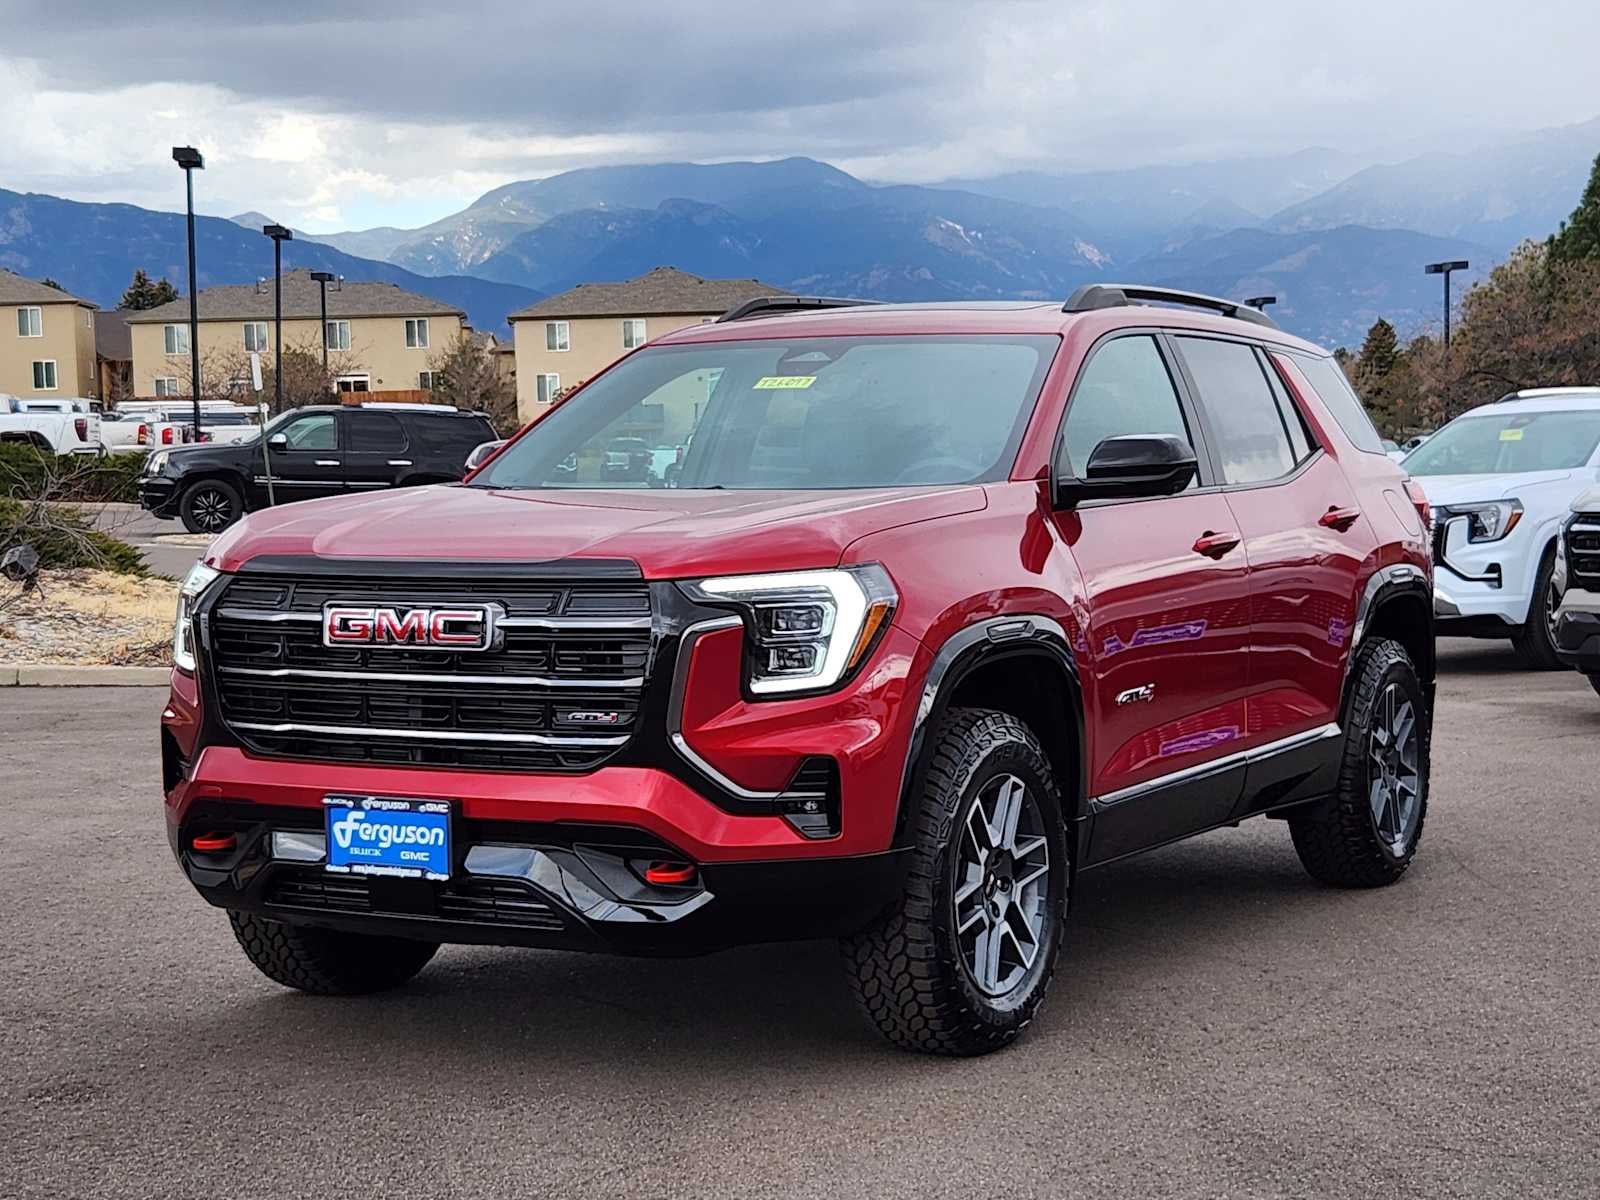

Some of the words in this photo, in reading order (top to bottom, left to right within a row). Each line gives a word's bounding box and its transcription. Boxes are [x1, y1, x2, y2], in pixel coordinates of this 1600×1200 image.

[328, 607, 483, 645] GMC
[362, 797, 410, 810] Ferguson
[425, 803, 449, 813] GMC
[333, 811, 445, 848] Ferguson
[350, 847, 382, 857] BUICK
[400, 850, 430, 861] GMC
